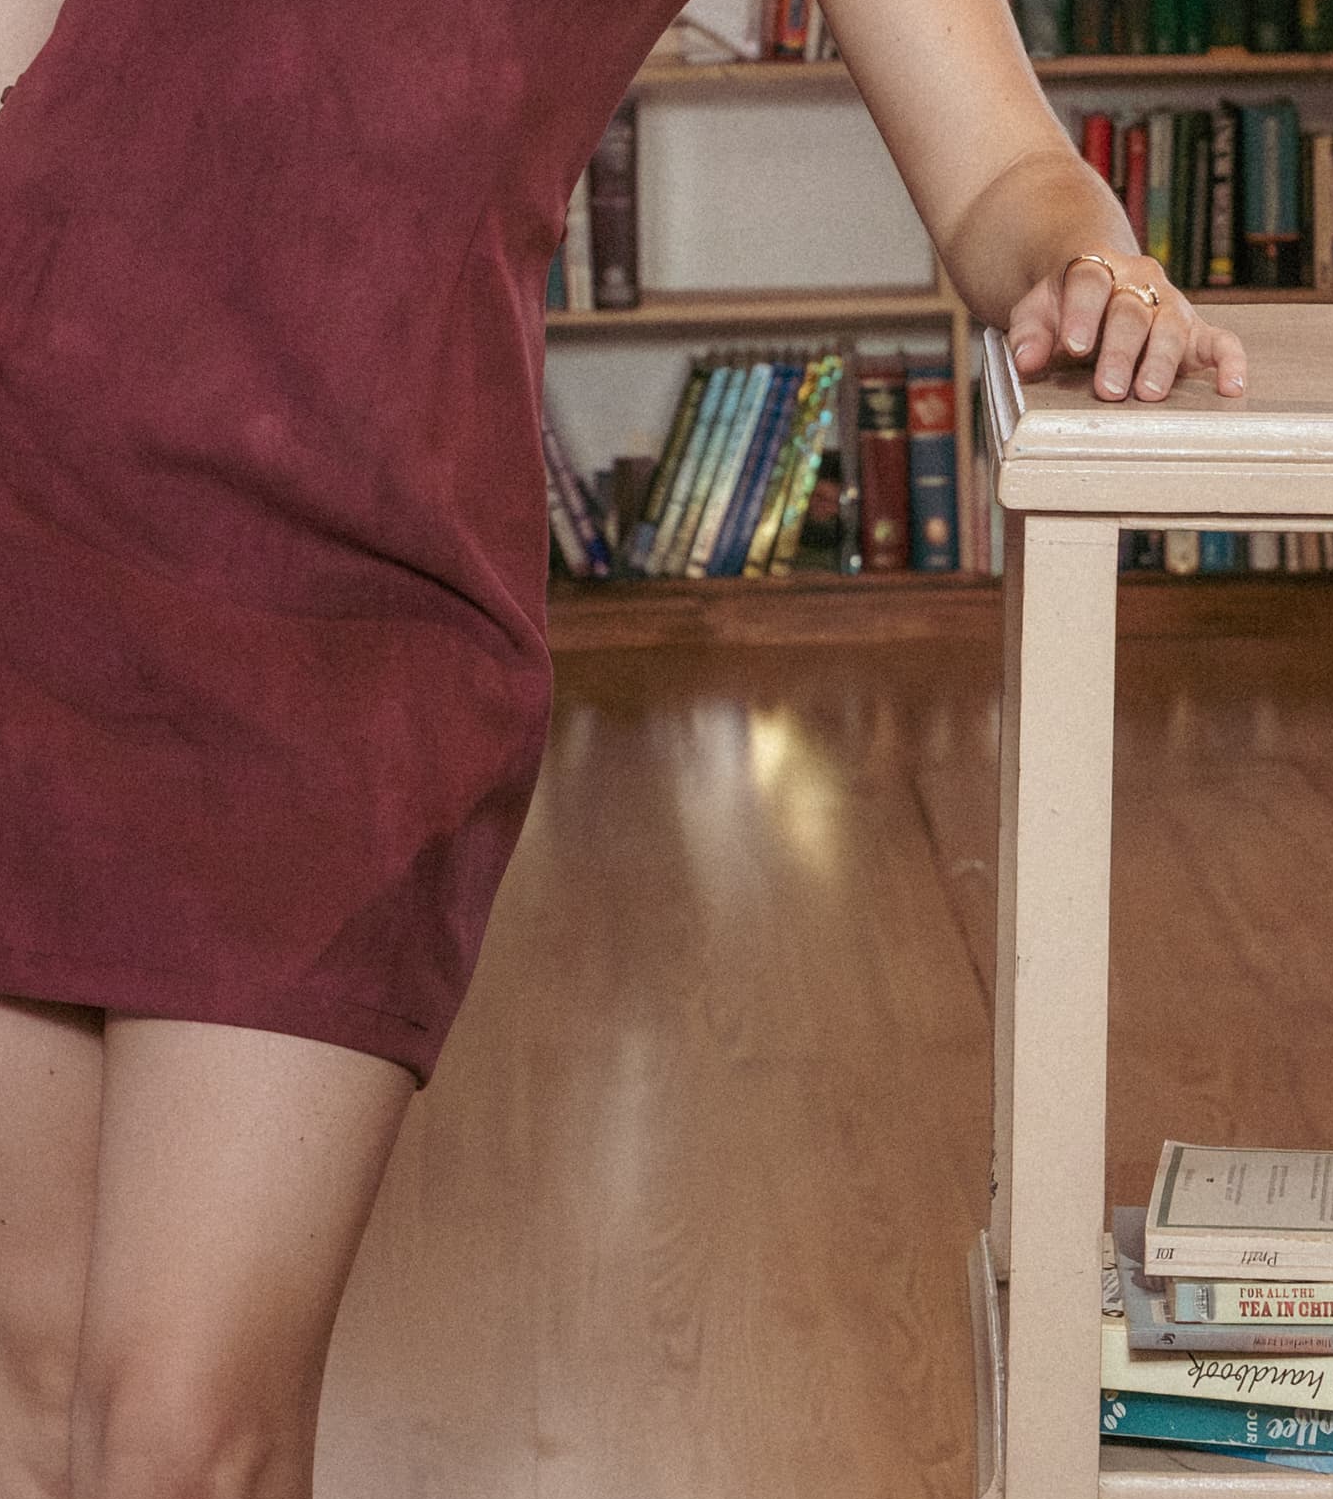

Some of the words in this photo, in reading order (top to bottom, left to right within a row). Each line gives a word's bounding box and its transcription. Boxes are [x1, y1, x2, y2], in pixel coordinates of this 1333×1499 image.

[1240, 1250, 1279, 1268] Pratt
[1239, 1287, 1264, 1299] FOR
[1266, 1287, 1291, 1299] ALL
[1292, 1287, 1316, 1299] THE
[1238, 1300, 1273, 1318] TEA
[1276, 1300, 1296, 1318] IN
[1185, 1351, 1327, 1399] handbook
[1245, 1409, 1259, 1444] OUR
